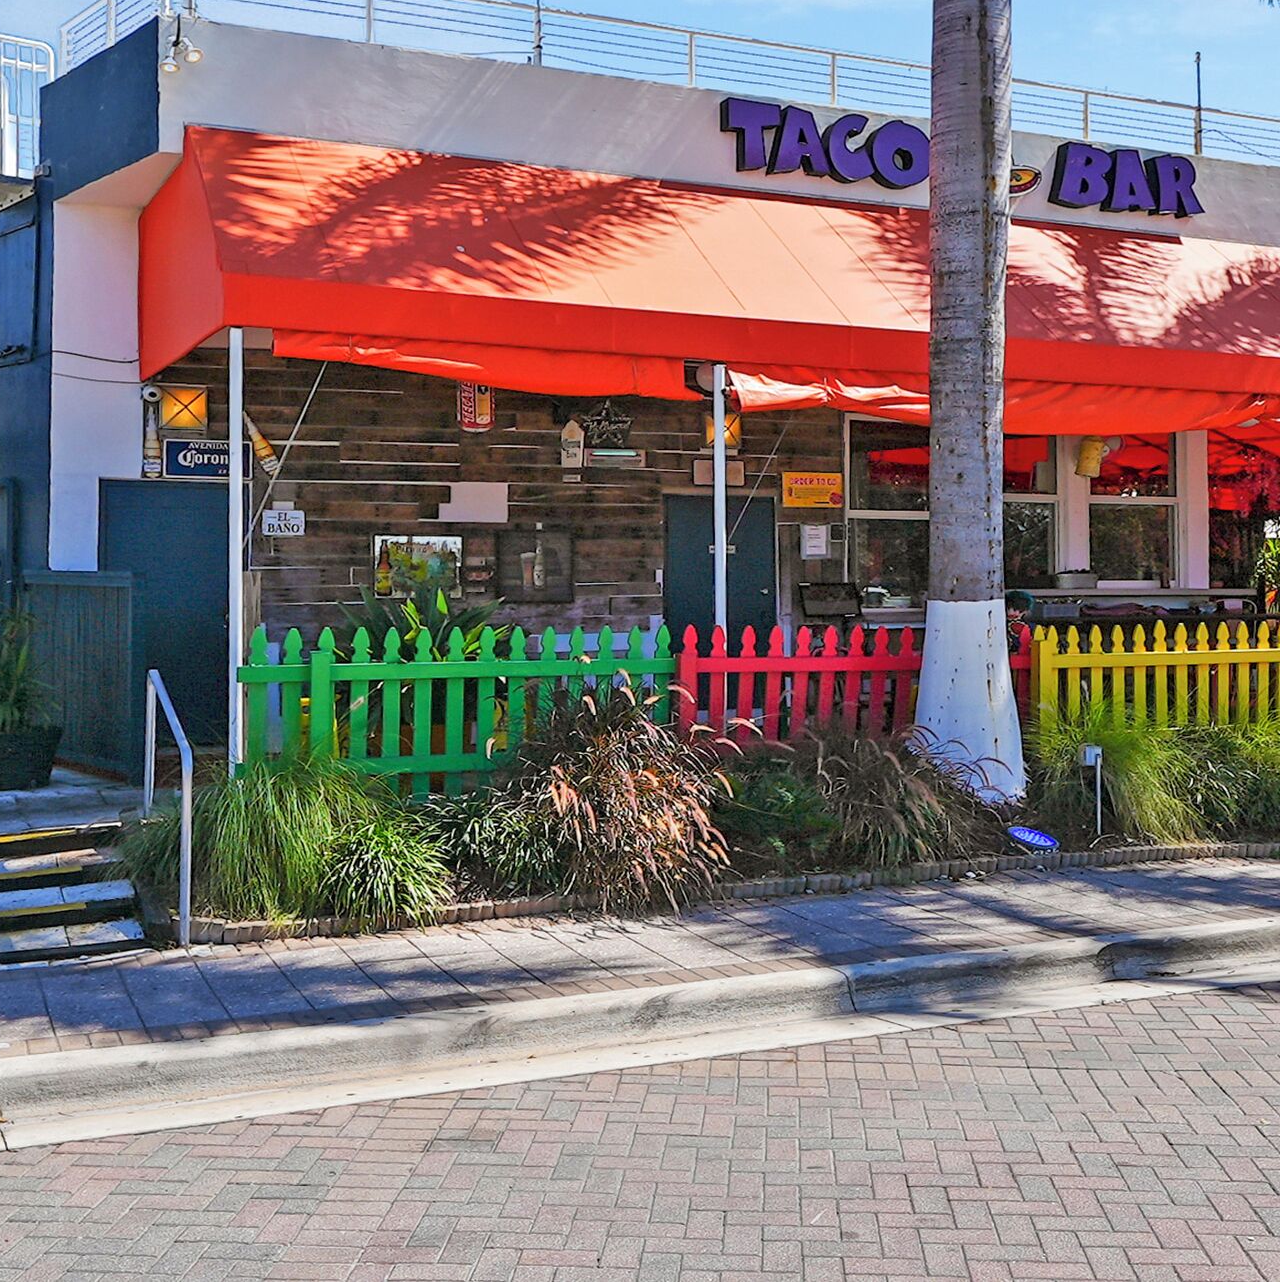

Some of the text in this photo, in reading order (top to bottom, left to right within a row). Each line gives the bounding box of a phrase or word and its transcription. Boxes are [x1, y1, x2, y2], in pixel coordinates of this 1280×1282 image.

[720, 97, 1205, 218] TACO BAR
[461, 381, 475, 423] TECATE
[188, 442, 229, 450] AVENIDA
[178, 449, 229, 468] Coron
[277, 512, 291, 522] EL
